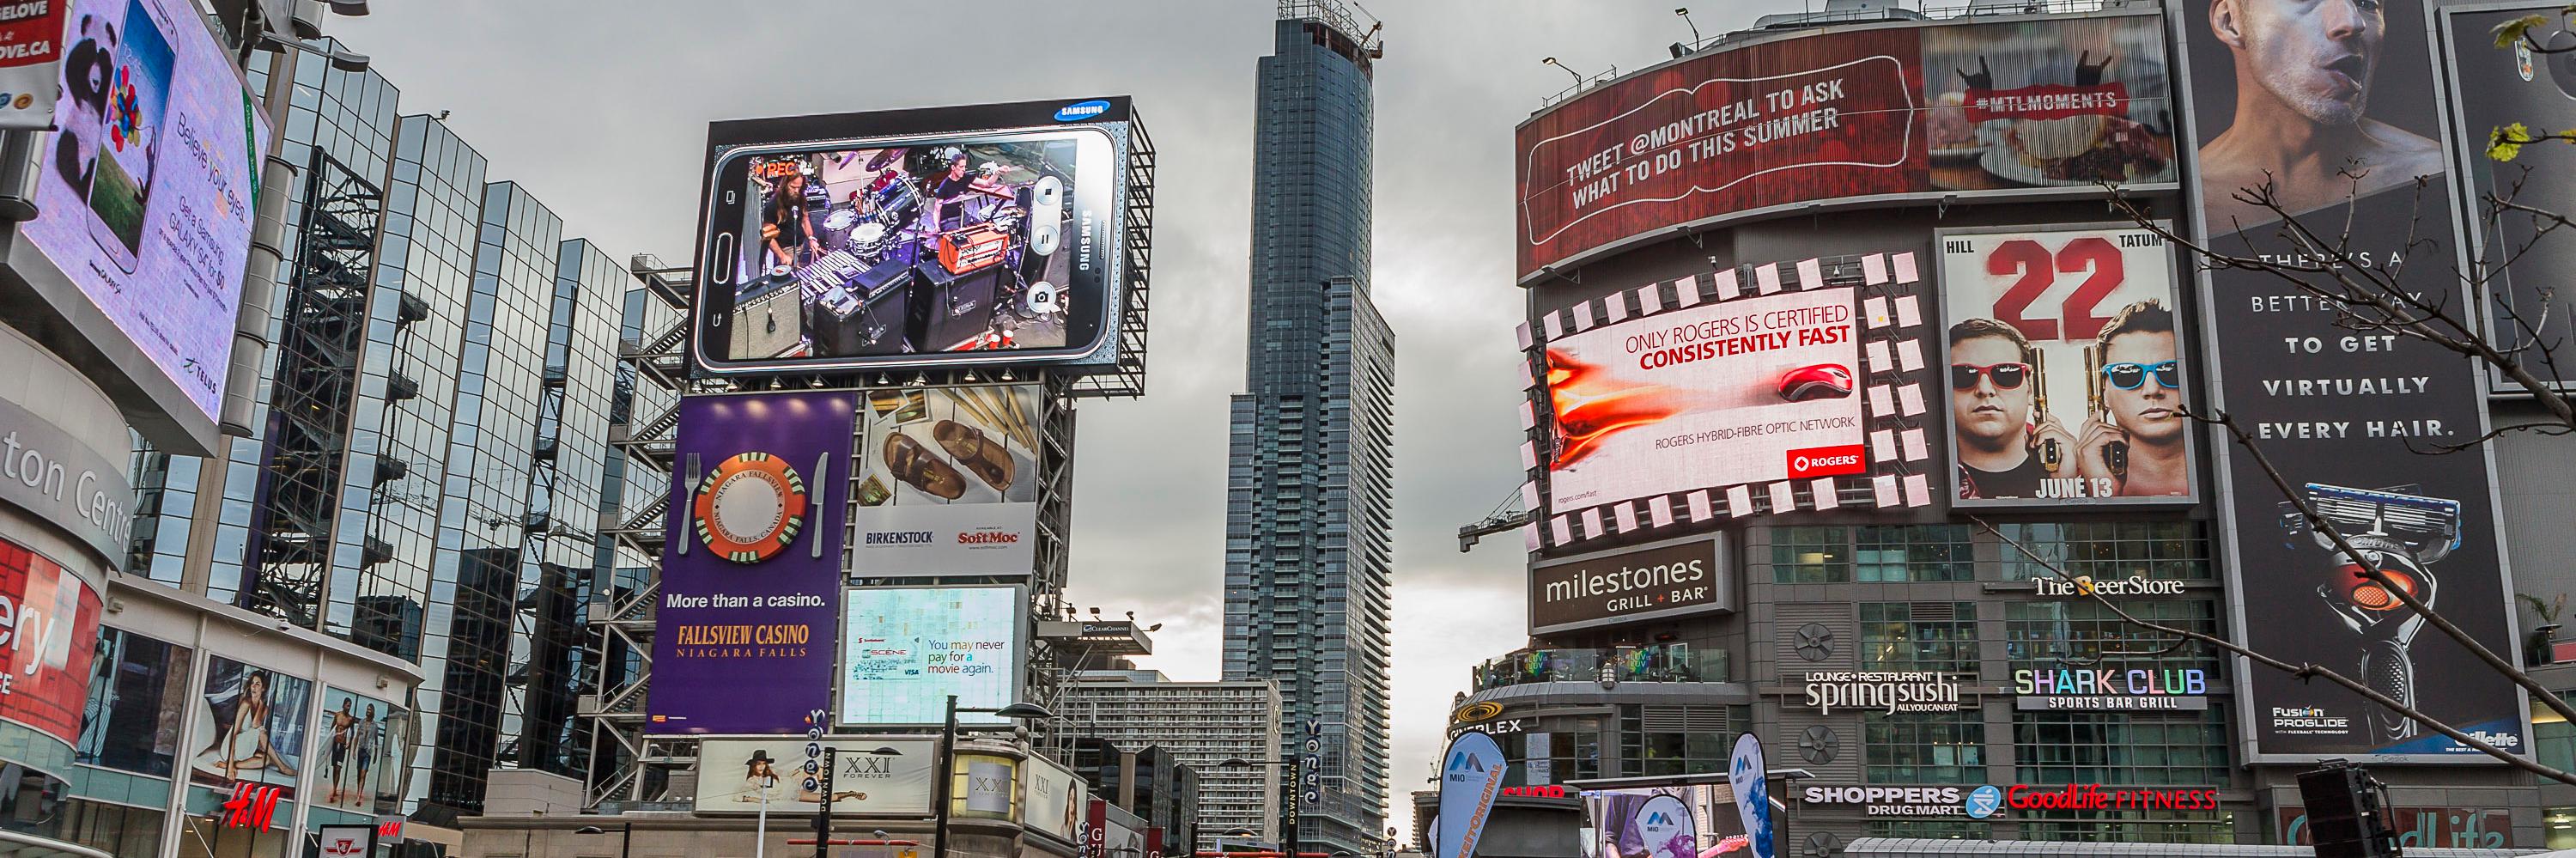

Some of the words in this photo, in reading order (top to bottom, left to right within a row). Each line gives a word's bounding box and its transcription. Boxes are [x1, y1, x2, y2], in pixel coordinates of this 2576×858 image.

[0, 1, 48, 21] ELOVE
[1061, 105, 1104, 116] SAMSUNG
[1976, 91, 2117, 113] #MTLMOMENTS
[1567, 143, 1625, 186] TWEET
[1631, 99, 1760, 155] @MONTREAL
[1766, 88, 1794, 113] TO
[1801, 78, 1845, 105] ASK
[177, 111, 208, 169] Believe
[207, 161, 227, 194] your
[1572, 172, 1620, 210] WHAT
[1625, 160, 1649, 186] TO
[1656, 149, 1681, 175] DO
[1688, 131, 1736, 163] THIS
[1744, 107, 1839, 148] SUMMER
[767, 161, 796, 178] REC
[179, 196, 191, 221] Get
[191, 215, 197, 229] a
[197, 218, 224, 265] Samsung
[1079, 210, 1093, 271] SAMSUNG
[169, 212, 198, 256] GALAXY
[208, 259, 217, 280] for
[1946, 240, 1975, 254] HILL
[2118, 234, 2163, 249] TATUM
[2389, 251, 2403, 267] A
[1986, 237, 2124, 342] 22
[2251, 295, 2348, 312] BETTER
[1626, 329, 1668, 354] ONLY
[1674, 317, 1740, 344] ROGERS
[1745, 314, 1759, 333] IS
[1764, 305, 1849, 330] CERTIFIED
[1639, 331, 1792, 370] CONSISTENTLY
[1799, 326, 1850, 347] FAST
[2285, 337, 2323, 353] TO
[2341, 335, 2396, 352] GET
[196, 365, 217, 394] TELUS
[2263, 376, 2430, 397] VIRTUALLY
[1656, 434, 1695, 450] ROGERS
[1697, 424, 1763, 444] HYBRID-FIBRE
[1765, 421, 1797, 435] OPTIC
[1800, 416, 1856, 432] NETWORK
[2259, 422, 2350, 440] EVERY
[2366, 419, 2455, 437] HAIR.
[1811, 455, 1857, 467] ROGERS
[716, 472, 747, 502] NIAGARA
[749, 470, 784, 502] FALLSVIEW
[2035, 478, 2087, 498] JUNE
[2090, 478, 2113, 498] 13
[1558, 490, 1597, 505] rogers.com/fast
[76, 470, 131, 554] Centre
[714, 511, 733, 541] NIAGARA
[760, 510, 783, 538] CANADA
[866, 531, 933, 545] BIRKENSTOCK
[1546, 559, 1704, 603] milestones
[2032, 577, 2074, 596] The
[2075, 575, 2129, 596] Beer
[2129, 575, 2185, 595] Store
[666, 593, 708, 608] More
[713, 593, 749, 608] than
[752, 596, 762, 607] a
[768, 593, 825, 607] casino.
[1607, 594, 1653, 612] GRILL
[677, 625, 753, 645] FALLSVIEW
[756, 624, 810, 645] CASINO
[677, 648, 752, 658] NIAGARA
[759, 648, 807, 658] FALLS
[928, 640, 948, 650] You
[951, 642, 974, 653] may
[975, 642, 1005, 650] never
[928, 653, 950, 665] pay
[949, 651, 965, 661] for
[927, 664, 960, 674] movie
[962, 664, 994, 677] again.
[1806, 672, 1851, 682] LOUNGE
[1858, 672, 1933, 682] RESTAURANT
[2014, 669, 2117, 694] SHARK
[2127, 669, 2206, 694] CLUB
[2049, 697, 2099, 709] SPORTS
[2106, 697, 2133, 709] BAR
[2139, 697, 2178, 709] GRILL
[2274, 719, 2348, 727] PROGLIDE
[802, 709, 826, 792] Yonge
[845, 757, 891, 773] XXI
[1303, 719, 1322, 805] Yonge
[821, 752, 831, 812] DOWNTOWN
[1035, 774, 1049, 794] XXI
[1449, 774, 1466, 782] MIO
[1735, 776, 1744, 785] MIO
[1804, 787, 1960, 804] SHOPPERS
[2008, 783, 2108, 809] GoodLife
[2116, 789, 2216, 810] FITNESS
[218, 782, 281, 833] H&M
[1868, 805, 1914, 815] DRUG
[1916, 805, 1960, 815] MART
[378, 821, 402, 837] H&M
